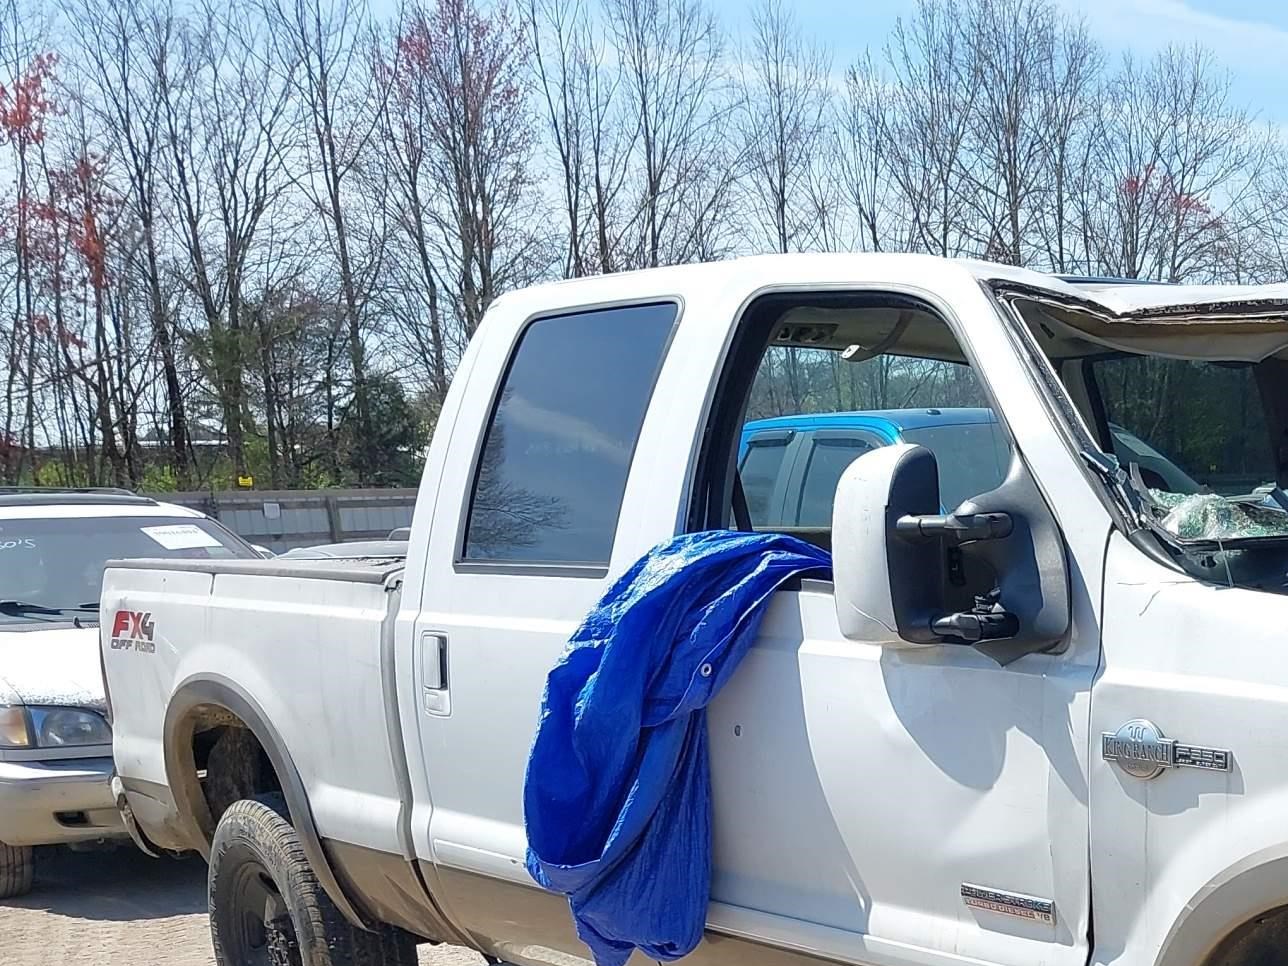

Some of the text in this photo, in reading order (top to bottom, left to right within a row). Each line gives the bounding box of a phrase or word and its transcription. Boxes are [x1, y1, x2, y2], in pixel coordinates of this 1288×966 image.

[111, 610, 155, 641] FX4
[111, 638, 133, 650] OFF
[1104, 737, 1170, 762] KING RANCH
